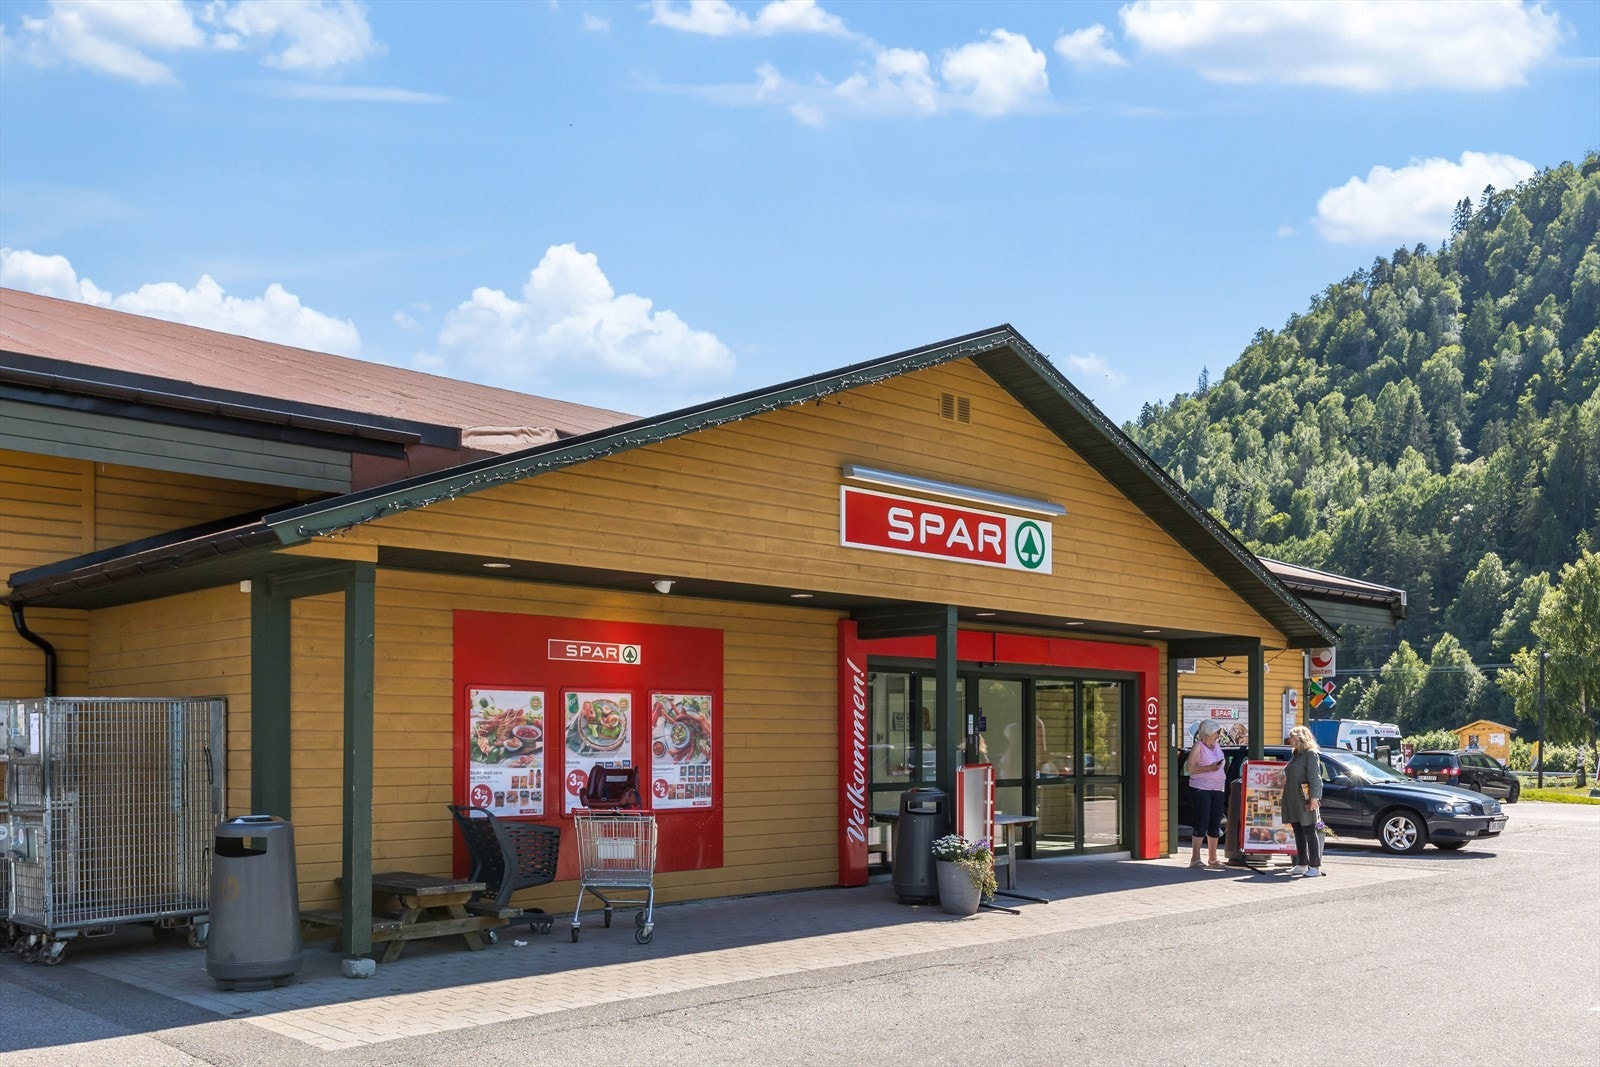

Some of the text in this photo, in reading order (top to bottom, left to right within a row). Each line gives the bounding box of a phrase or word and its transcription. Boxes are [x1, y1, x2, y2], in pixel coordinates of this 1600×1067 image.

[887, 506, 1002, 556] SPAR
[566, 644, 618, 659] SPAR
[1147, 696, 1159, 776] 8-21(19)
[847, 657, 865, 843] Velkommen!
[570, 773, 577, 786] 3
[655, 781, 661, 791] 3
[660, 787, 666, 797] 2
[474, 788, 481, 800] 3
[480, 795, 488, 807] 2
